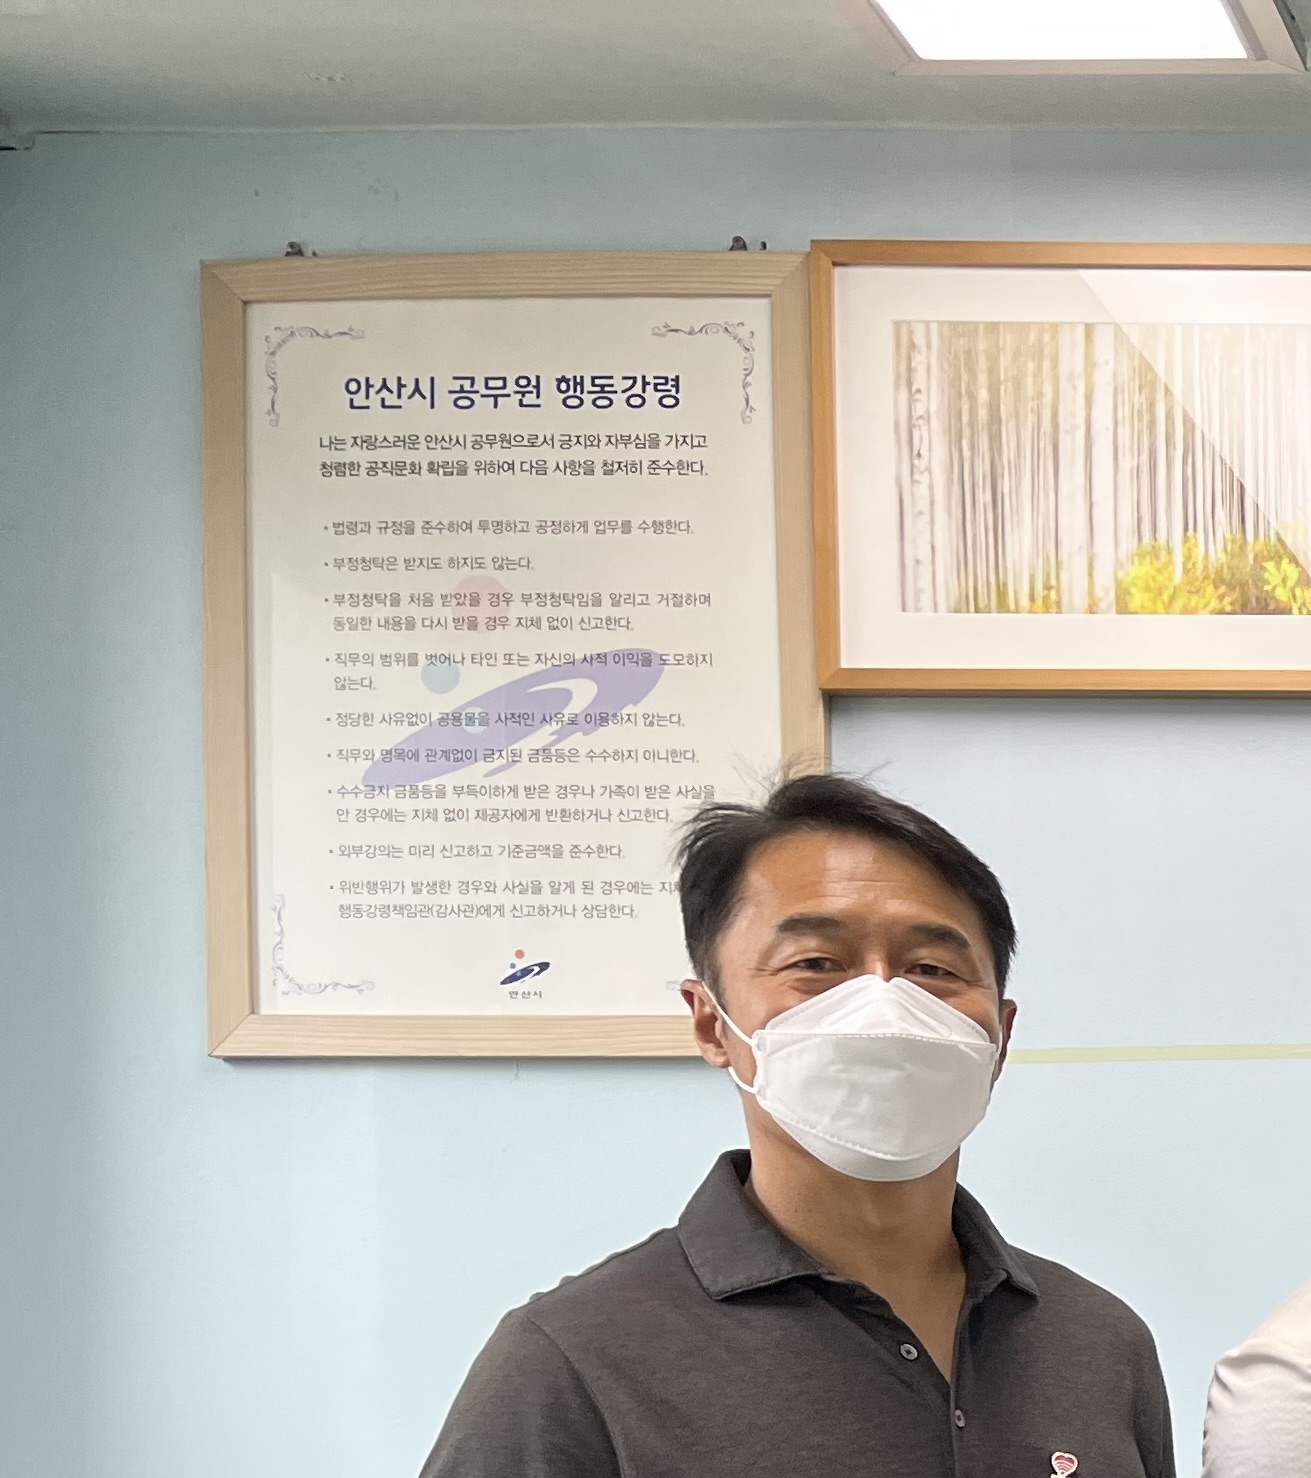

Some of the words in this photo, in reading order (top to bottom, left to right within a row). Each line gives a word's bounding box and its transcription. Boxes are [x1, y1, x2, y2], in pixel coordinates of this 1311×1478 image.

[344, 375, 436, 410] 안산시
[448, 374, 542, 410] 공무원
[555, 374, 681, 410] 행동강령
[319, 435, 347, 451] 나는
[350, 434, 420, 451] 자랑스러운
[424, 434, 467, 450] 안산시
[471, 433, 555, 450] 공무원으로서
[558, 433, 601, 449] 긍지와
[605, 433, 661, 449] 자부심을
[664, 433, 708, 449] 가지고
[320, 461, 361, 477] 청렴한
[365, 461, 422, 476] 공직문화
[427, 460, 468, 476] 확립을
[474, 460, 516, 476] 위하여
[520, 460, 548, 476] 다음
[553, 460, 595, 476] 사항을
[601, 460, 643, 476] 철저히
[646, 460, 709, 476] 준수한다.
[332, 521, 371, 535] 법령과
[376, 520, 415, 535] 규정을
[421, 520, 473, 535] 준수하여
[478, 520, 530, 534] 투명하고
[535, 520, 589, 534] 공정하게
[594, 520, 632, 534] 업무를
[638, 520, 694, 534] 수행한다.
[333, 557, 399, 572] 부정청탁은
[403, 556, 443, 571] 받지도
[448, 556, 487, 571] 하지도
[491, 556, 535, 571] 않는다.
[333, 592, 401, 607] 부정청탁을
[408, 592, 434, 607] 처음
[441, 592, 481, 607] 받았을
[488, 592, 514, 607] 경우
[520, 592, 602, 607] 부정청탁임을
[609, 592, 650, 607] 알리고
[657, 592, 711, 607] 거절하며
[333, 616, 372, 631] 동일한
[377, 616, 416, 631] 내용을
[422, 616, 447, 631] 다시
[452, 616, 478, 631] 받을
[484, 616, 511, 631] 경우
[515, 616, 542, 631] 지체
[547, 616, 573, 631] 없이
[578, 616, 634, 631] 신고한다.
[334, 652, 375, 667] 직무의
[380, 652, 419, 667] 범위를
[425, 652, 466, 667] 벗어나
[471, 652, 497, 667] 타인
[502, 653, 529, 666] 또는
[535, 652, 575, 667] 자신의
[580, 652, 608, 667] 사적
[613, 652, 652, 667] 이익을
[658, 652, 713, 667] 도모하지
[333, 676, 377, 691] 않는다.
[335, 712, 374, 727] 정당한
[379, 712, 432, 727] 사유없이
[437, 712, 490, 727] 공용물을
[495, 712, 534, 726] 사적인
[540, 712, 579, 726] 사유로
[584, 712, 637, 727] 이용하지
[642, 712, 685, 727] 않는다.
[336, 748, 375, 763] 직무와
[380, 748, 420, 763] 명목에
[424, 748, 477, 763] 관계없이
[483, 748, 522, 763] 금지된
[527, 748, 579, 763] 금품등은
[585, 748, 638, 763] 수수하지
[643, 749, 699, 763] 아니한다.
[337, 785, 389, 799] 수수금지
[395, 785, 447, 799] 금품등을
[452, 785, 518, 799] 부득이하게
[524, 785, 550, 799] 받은
[555, 785, 595, 799] 경우나
[600, 785, 639, 799] 가족이
[644, 785, 671, 799] 받은
[676, 785, 715, 800] 사실을
[336, 809, 349, 823] 안
[354, 808, 406, 823] 경우에는
[411, 808, 438, 823] 지체
[443, 808, 469, 823] 없이
[474, 808, 541, 823] 제공자에게
[546, 808, 612, 823] 반환하거나
[617, 808, 673, 823] 신고한다.
[338, 844, 404, 859] 외부강의는
[409, 844, 434, 858] 미리
[440, 844, 493, 859] 신고하고
[498, 844, 564, 859] 기준금액을
[569, 844, 625, 859] 준수한다.
[339, 880, 405, 895] 위반행위가
[411, 880, 451, 895] 발생한
[457, 880, 497, 895] 경우와
[503, 880, 542, 895] 사실을
[548, 880, 575, 895] 알게
[581, 880, 594, 895] 된
[600, 880, 653, 895] 경우에는
[338, 904, 505, 919] 행동강령책임관(감사관)에게
[510, 904, 576, 919] 신고하거나
[581, 904, 638, 919] 상담한다.
